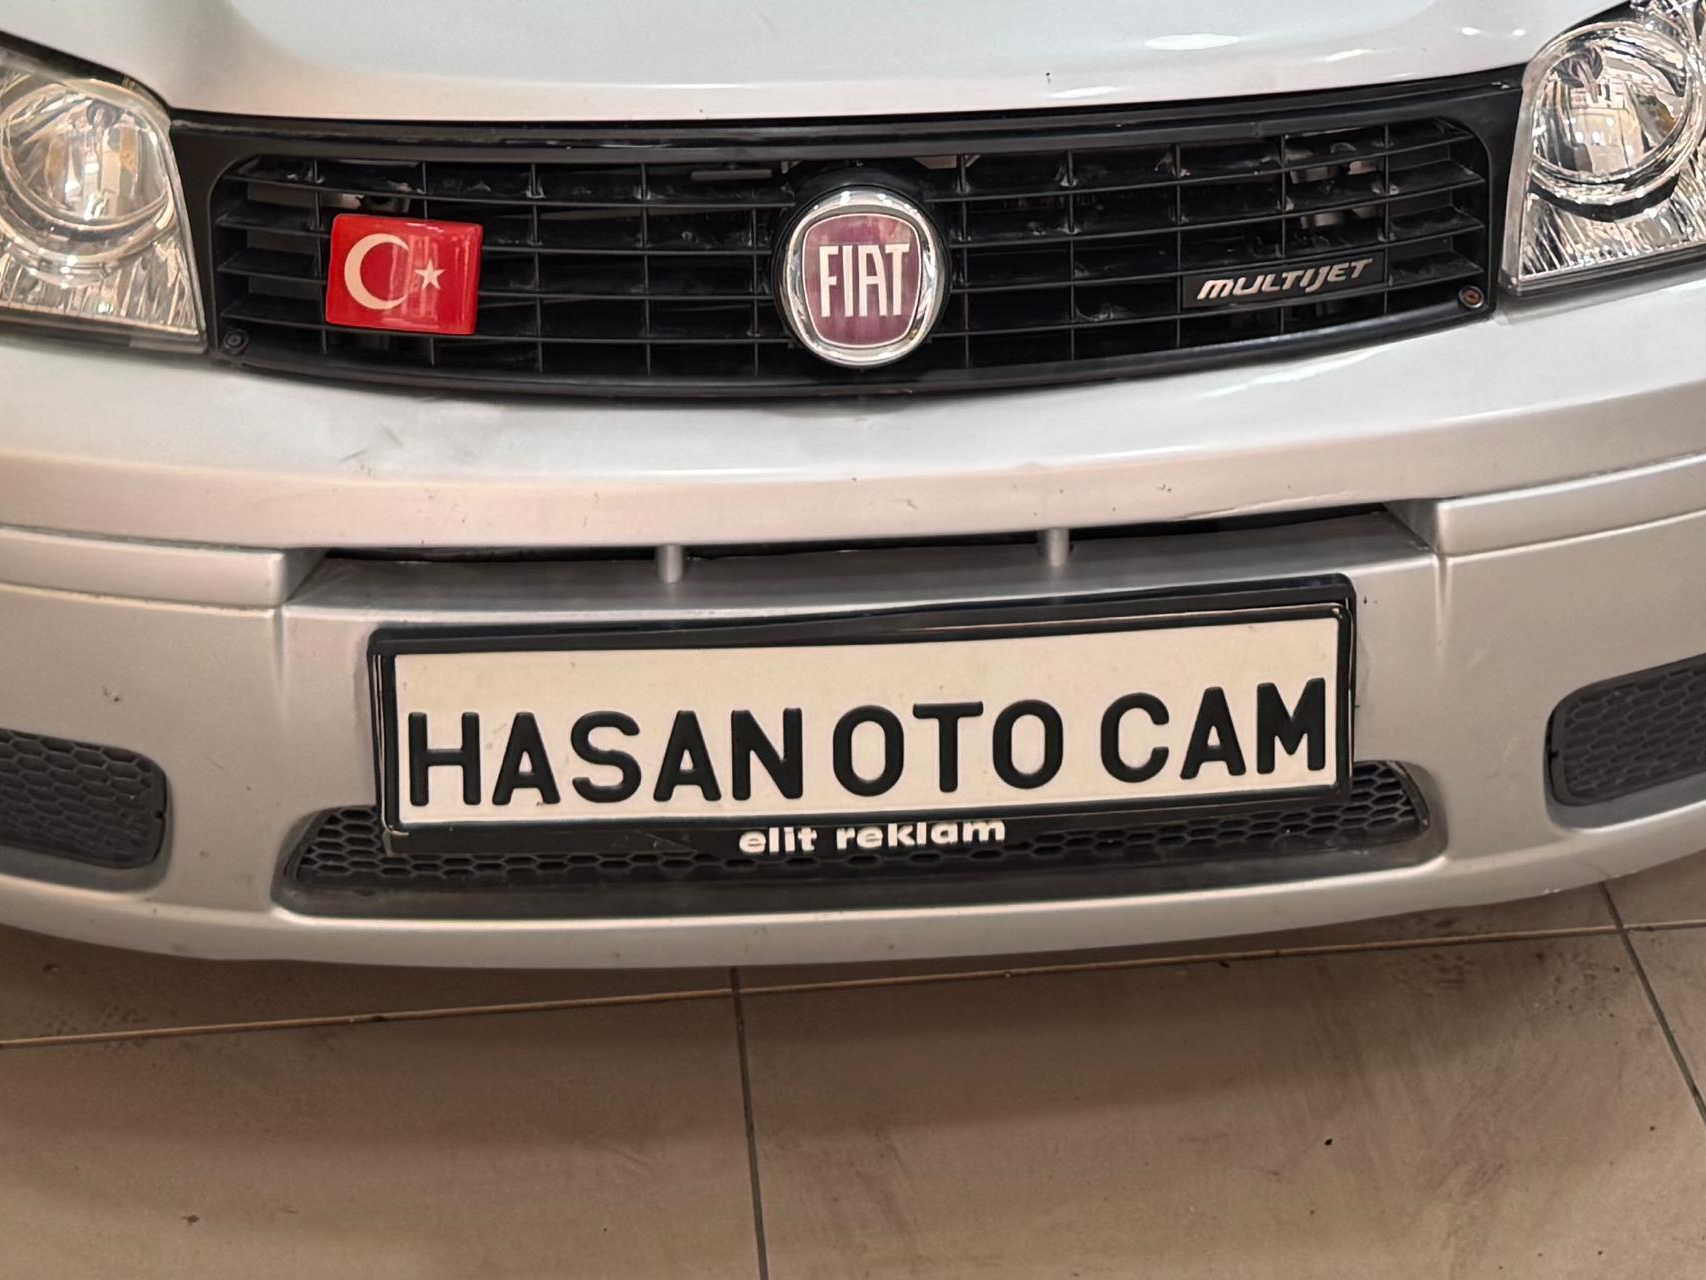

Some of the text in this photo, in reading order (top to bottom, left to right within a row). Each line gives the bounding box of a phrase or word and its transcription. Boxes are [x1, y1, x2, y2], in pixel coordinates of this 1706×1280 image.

[819, 243, 910, 317] FIAT
[1197, 258, 1373, 300] MULTIJET
[407, 677, 1326, 808] HASAN OTO CAM
[739, 818, 1006, 855] elit reklam
